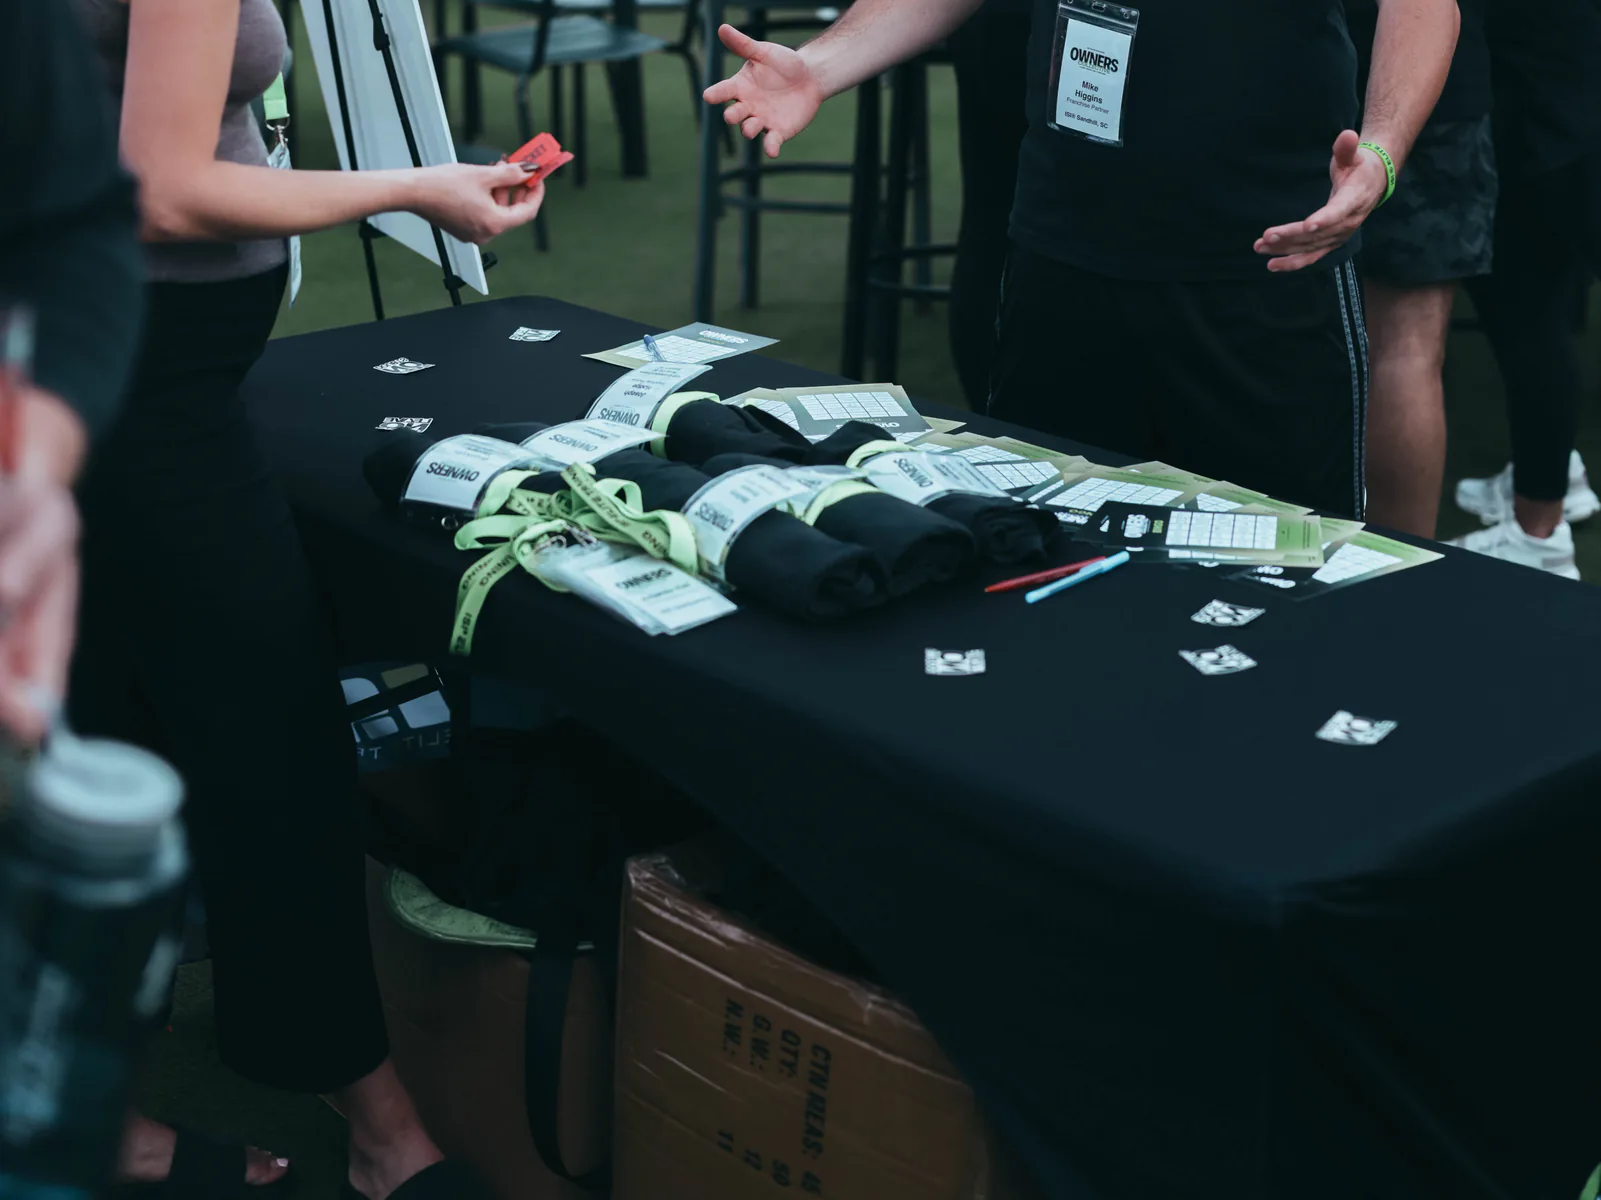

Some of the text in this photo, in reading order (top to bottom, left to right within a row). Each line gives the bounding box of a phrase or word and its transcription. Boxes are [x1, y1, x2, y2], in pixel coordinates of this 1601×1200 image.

[1070, 47, 1119, 73] OWNERS
[1081, 80, 1099, 92] Mike
[1074, 90, 1103, 104] Higgins
[1100, 121, 1109, 129] SC
[599, 407, 641, 428] OWNERS
[426, 461, 480, 483] OWNERS
[779, 1028, 801, 1081] QTY:
[808, 1042, 832, 1091] CTN
